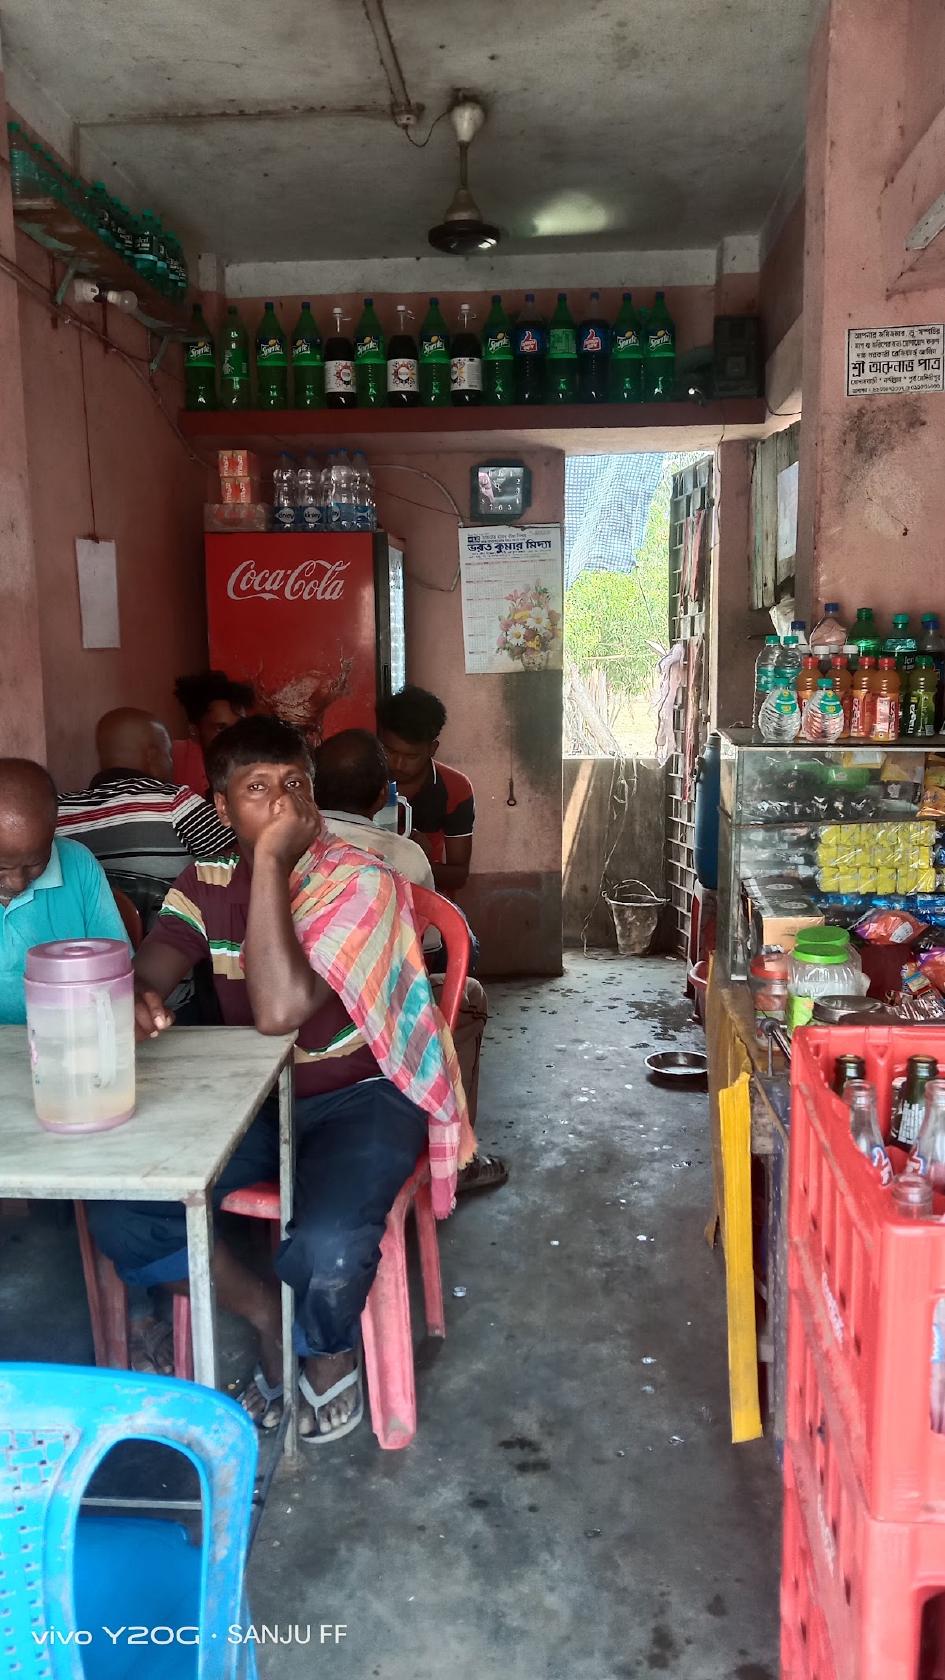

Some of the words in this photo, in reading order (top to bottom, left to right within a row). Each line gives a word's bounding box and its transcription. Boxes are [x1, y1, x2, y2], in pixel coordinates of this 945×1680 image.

[851, 360, 866, 378] শ্রী
[868, 359, 915, 375] অরুনাভ
[917, 357, 941, 371] পাত্র
[494, 542, 523, 554] কুমার
[227, 560, 351, 600] Coca-Cola
